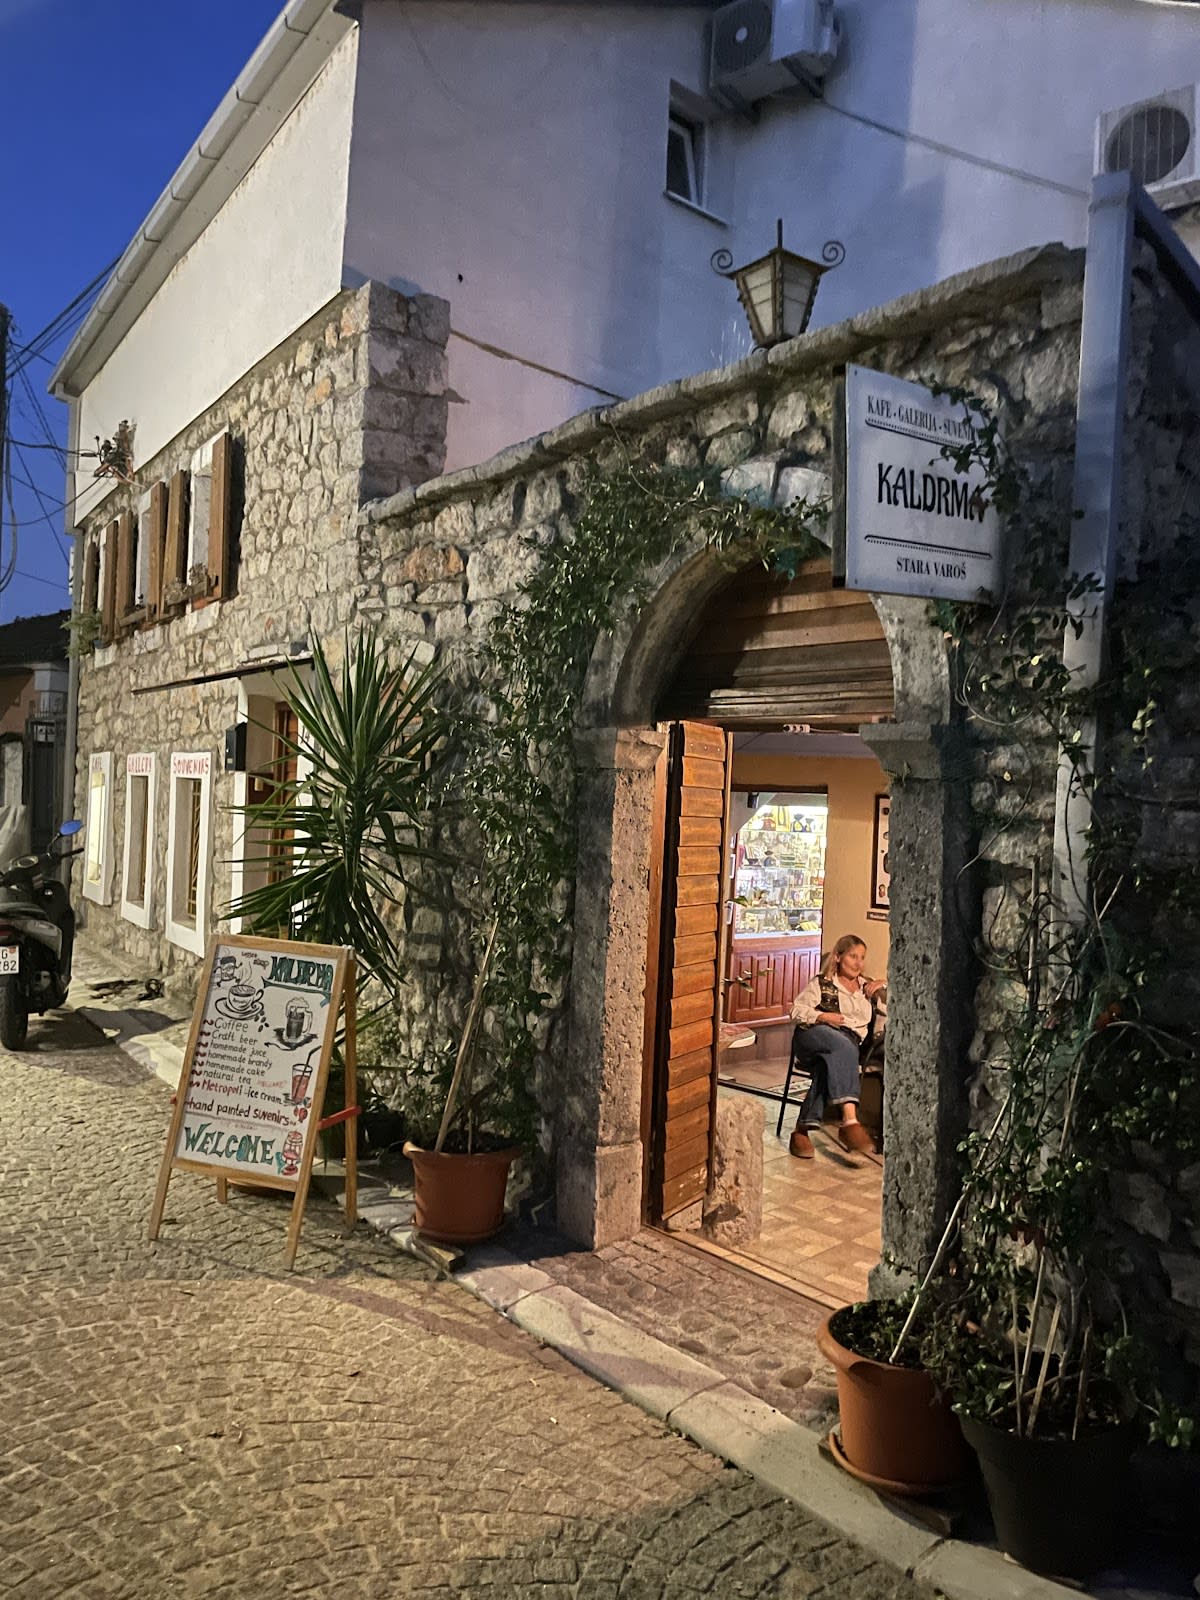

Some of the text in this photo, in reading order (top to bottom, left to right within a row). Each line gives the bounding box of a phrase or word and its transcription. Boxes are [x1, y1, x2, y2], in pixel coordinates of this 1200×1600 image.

[867, 395, 892, 418] KAFE
[898, 405, 937, 432] GALERIJA
[896, 556, 967, 580] STARA VAROŠ
[0, 960, 17, 971] 82
[214, 1017, 249, 1032] Coffee
[211, 1029, 258, 1046] Craft beer
[210, 1039, 267, 1058] homemade juice
[205, 1060, 266, 1077] homemade cake
[208, 1050, 273, 1070] homemade brandy
[202, 1069, 234, 1082] natural
[238, 1076, 252, 1085] tea
[189, 1097, 215, 1112] hand
[216, 1103, 251, 1117] painted
[184, 1122, 276, 1166] WELCOME
